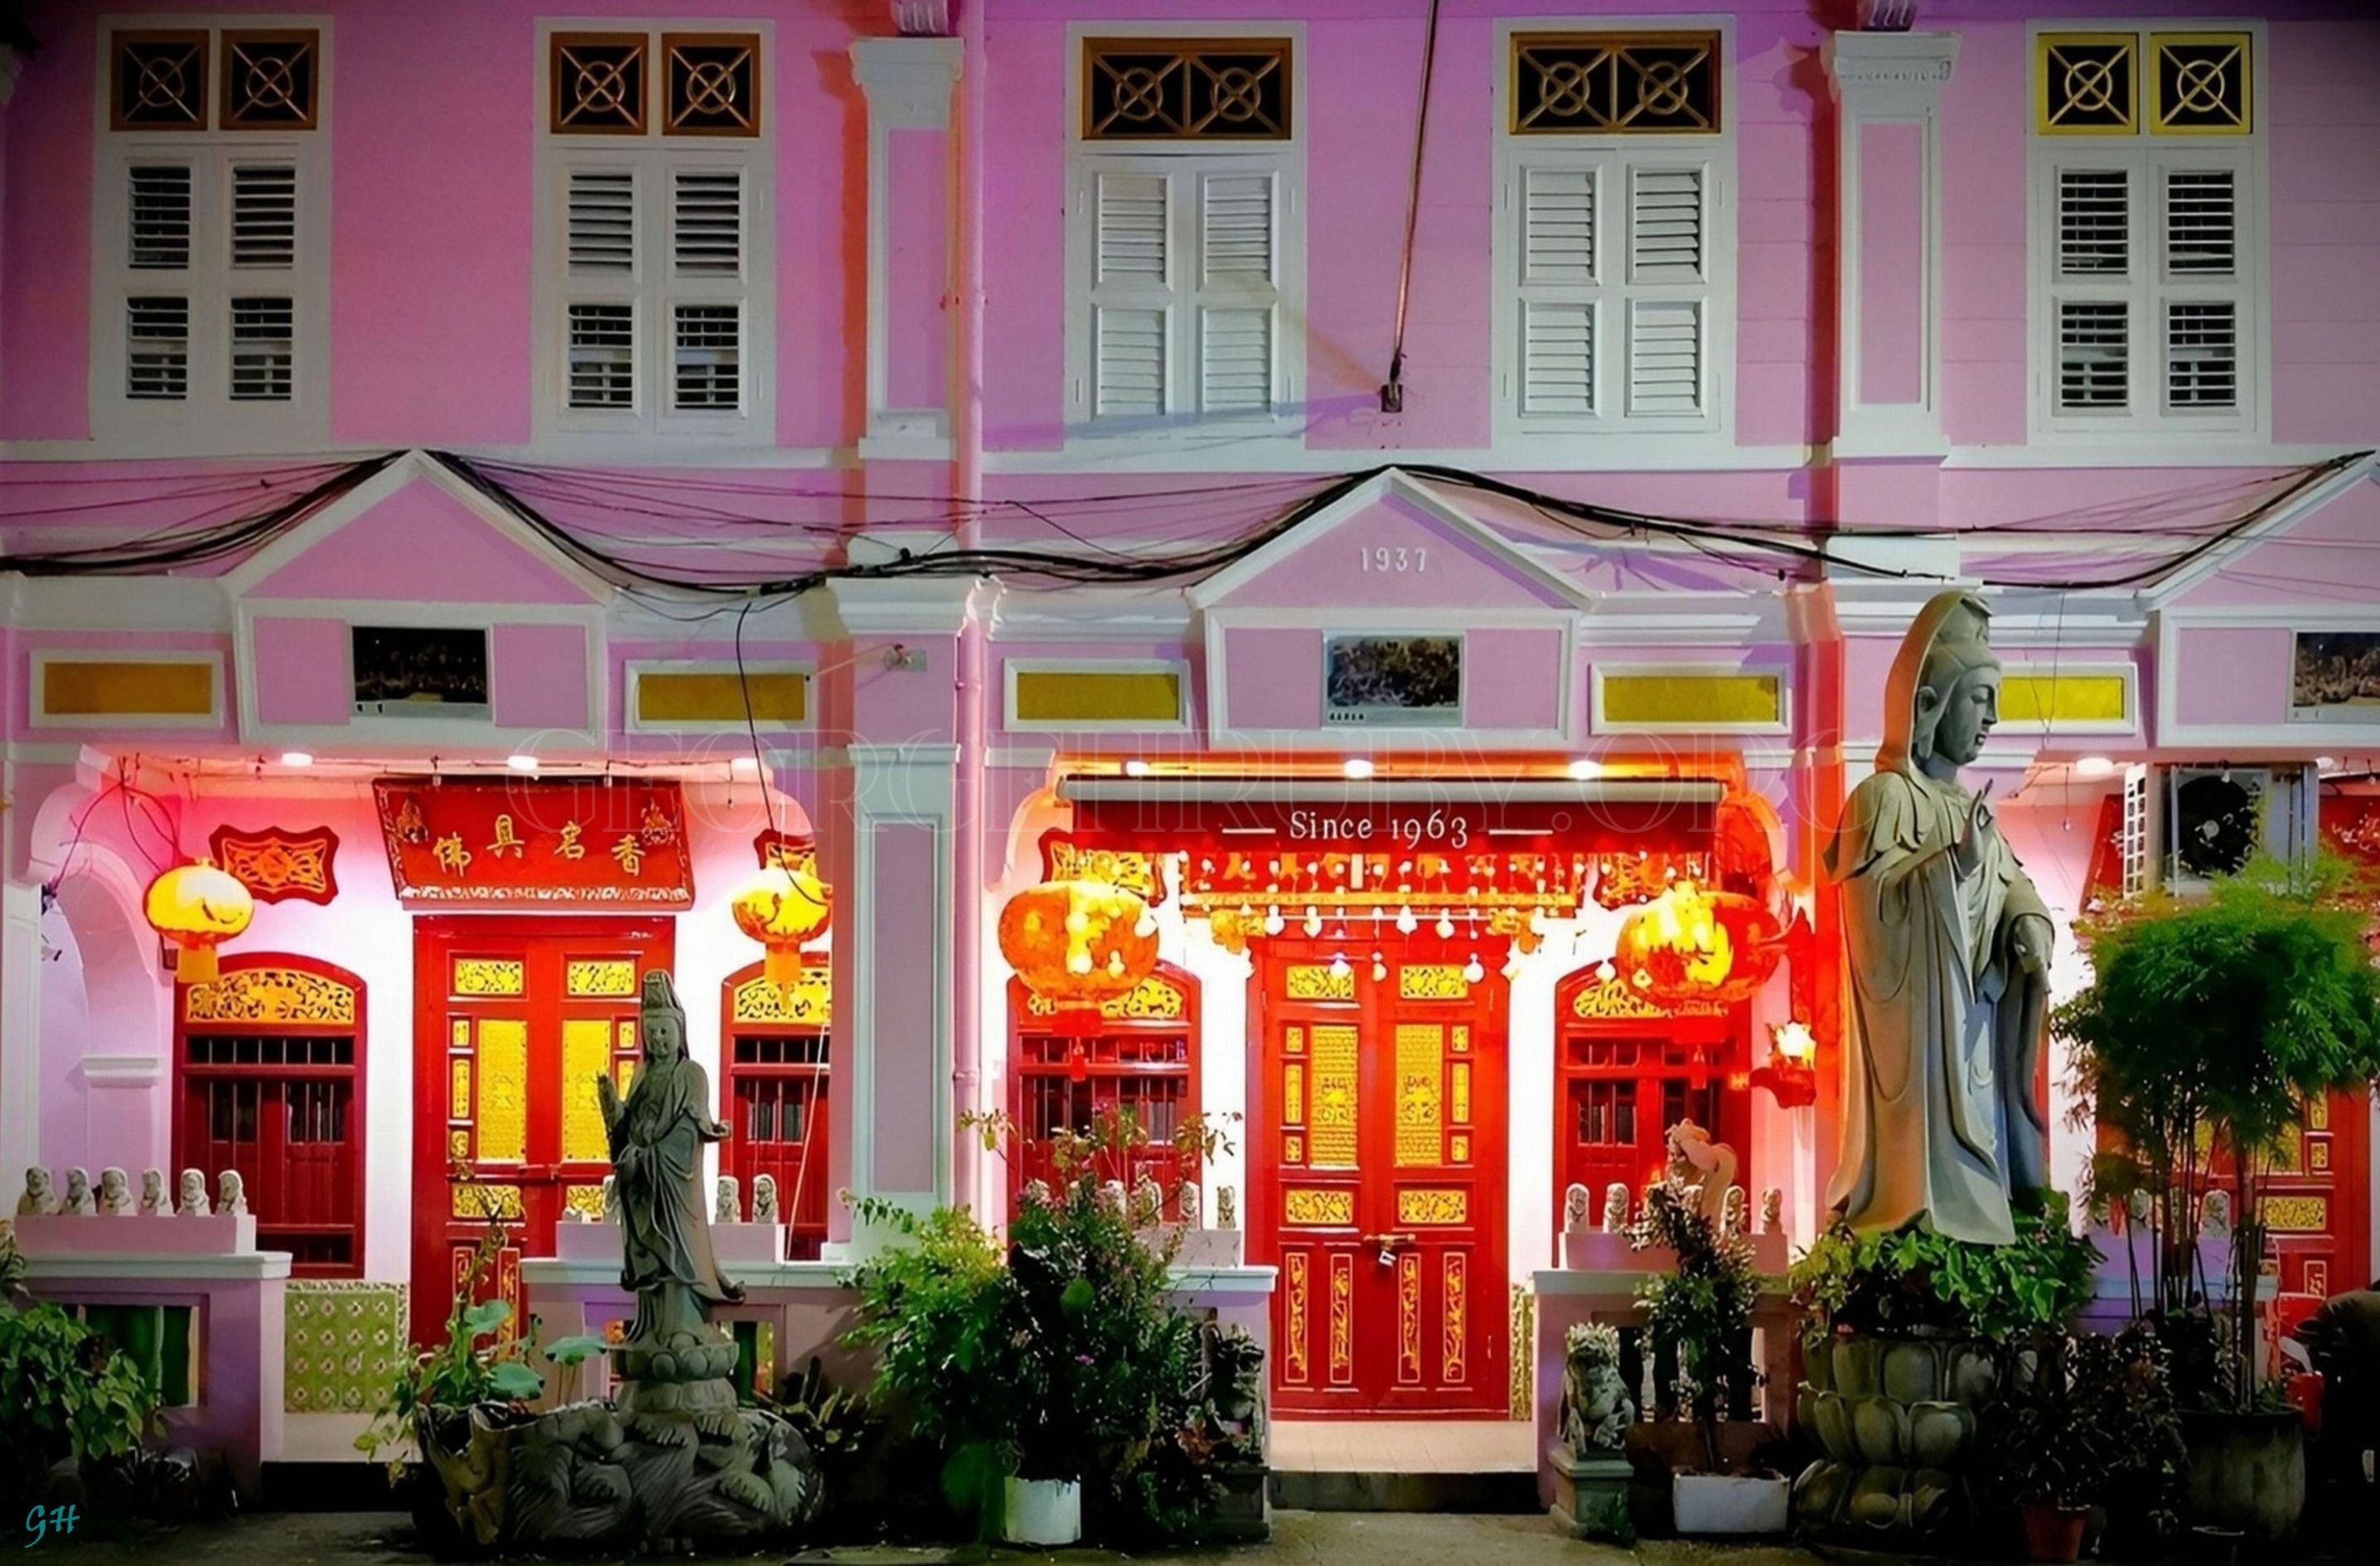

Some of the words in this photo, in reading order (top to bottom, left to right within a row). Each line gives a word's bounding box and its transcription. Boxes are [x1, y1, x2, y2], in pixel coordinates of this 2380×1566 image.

[1361, 546, 1427, 573] 1937
[1289, 810, 1373, 840] Since
[1391, 810, 1469, 849] 1963
